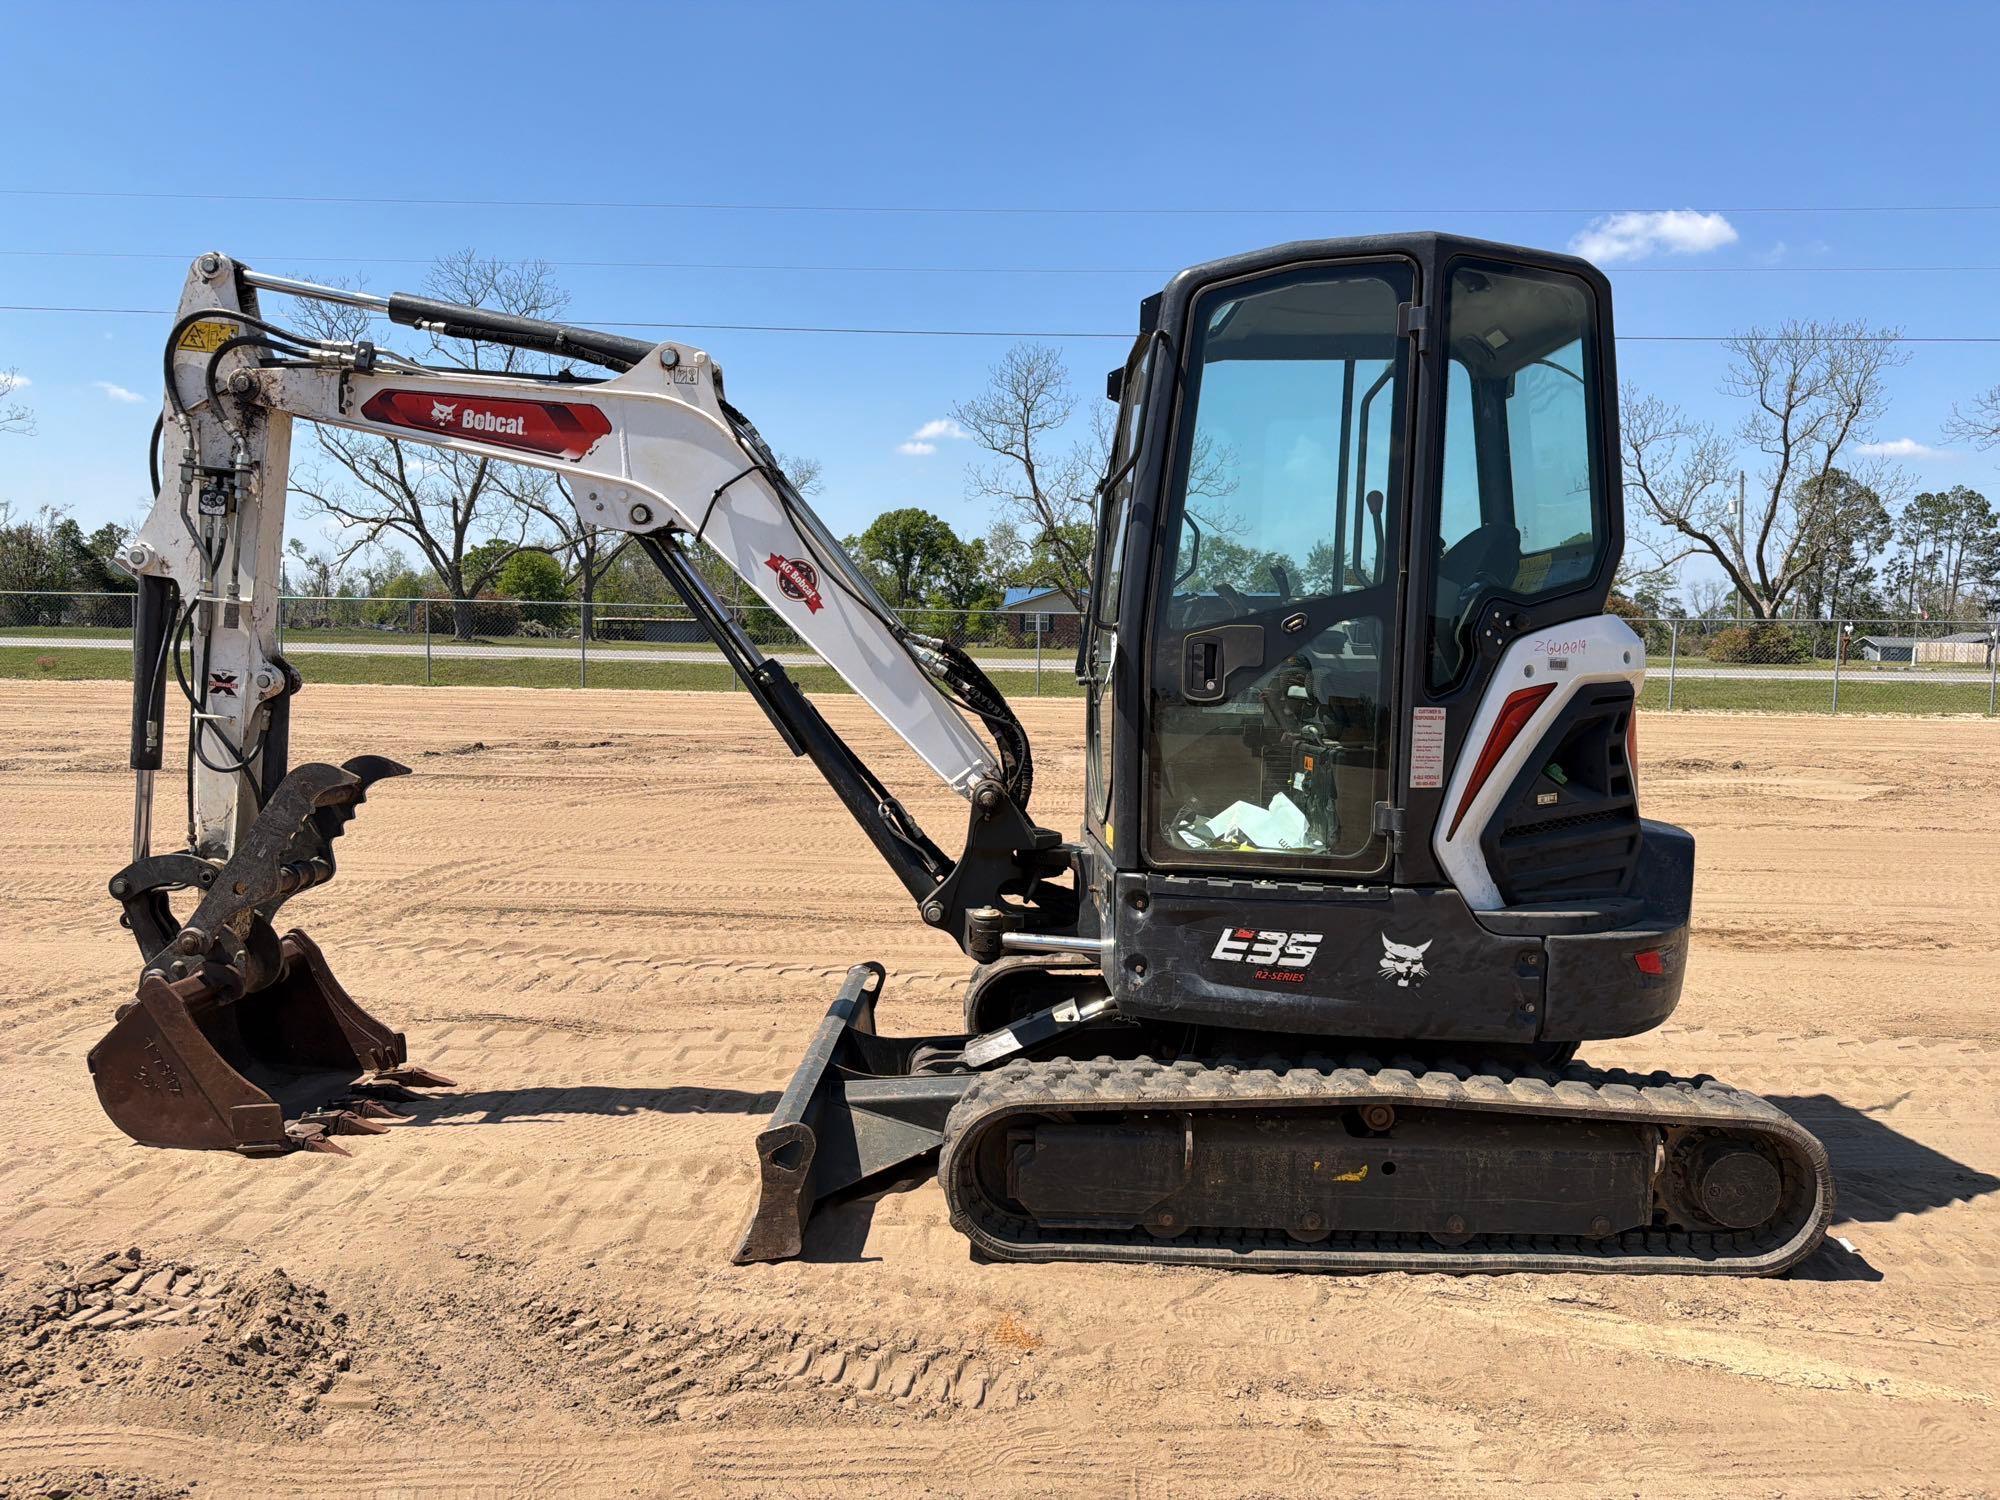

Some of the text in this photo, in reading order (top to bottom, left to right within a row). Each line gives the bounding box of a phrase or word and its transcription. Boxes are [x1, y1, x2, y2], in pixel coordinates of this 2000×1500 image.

[462, 409, 524, 435] Bobcat
[780, 561, 793, 573] KC
[791, 570, 816, 598] Bobcat
[1211, 928, 1324, 968] E35
[1254, 970, 1305, 982] R2-SERIES
